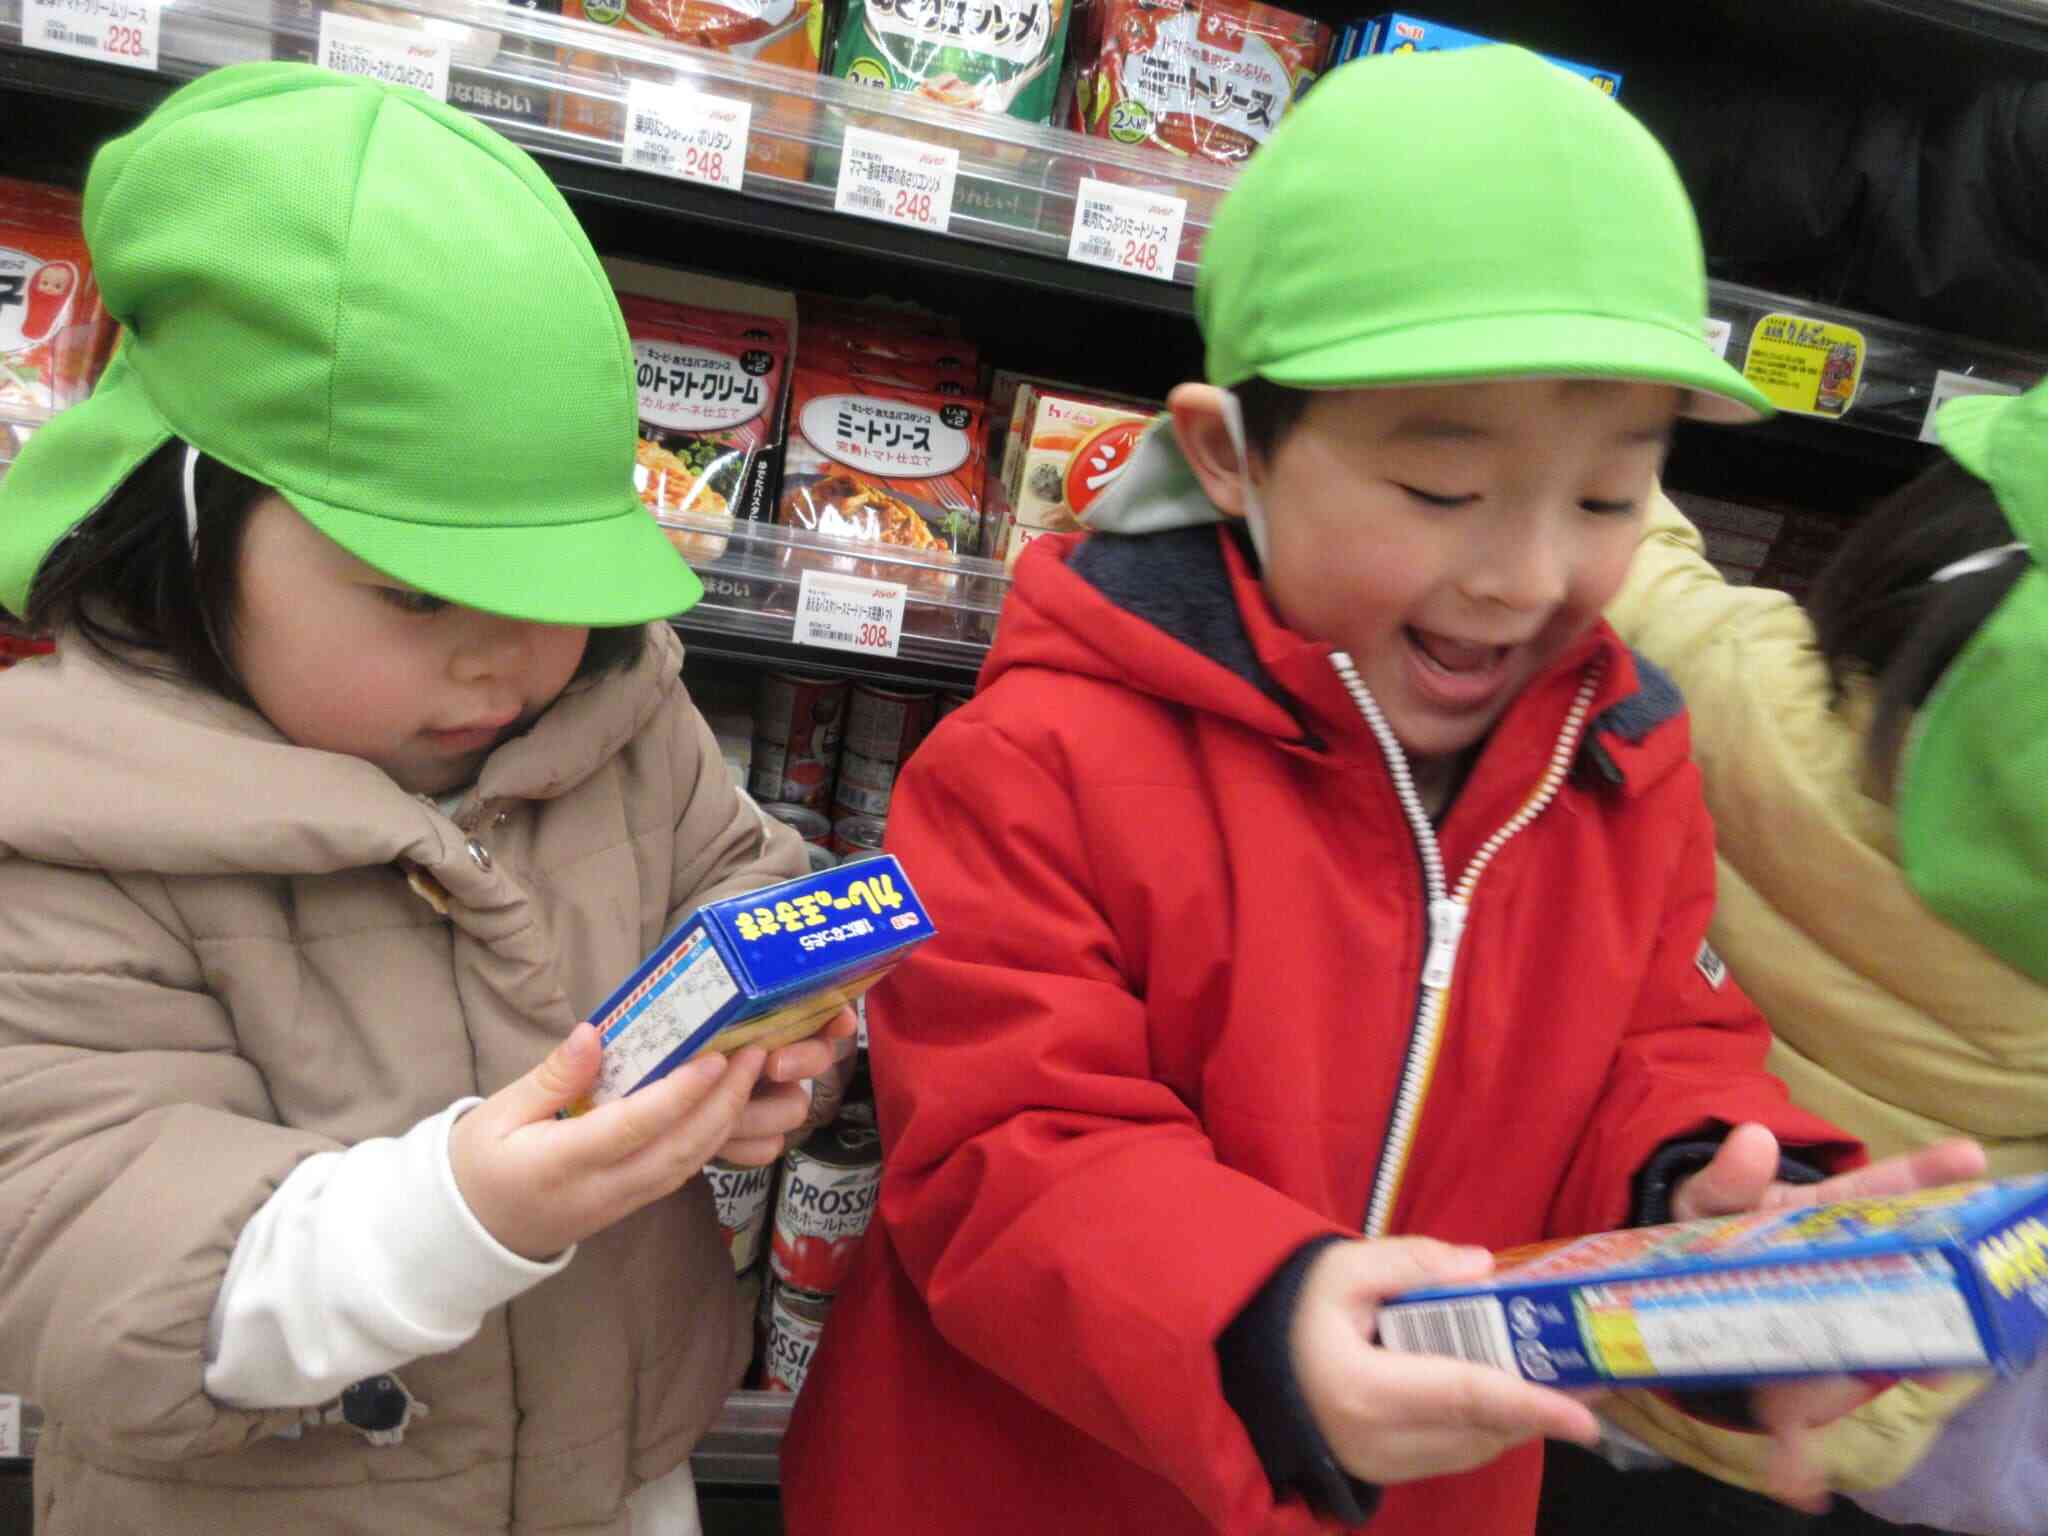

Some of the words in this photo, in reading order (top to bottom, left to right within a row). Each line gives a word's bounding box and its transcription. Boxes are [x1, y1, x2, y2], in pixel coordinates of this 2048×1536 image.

[109, 25, 143, 57] 228
[687, 147, 723, 181] 248
[894, 189, 931, 223] 248
[1123, 240, 1158, 272] 248
[837, 411, 931, 453] ミートソース
[859, 622, 888, 648] 308
